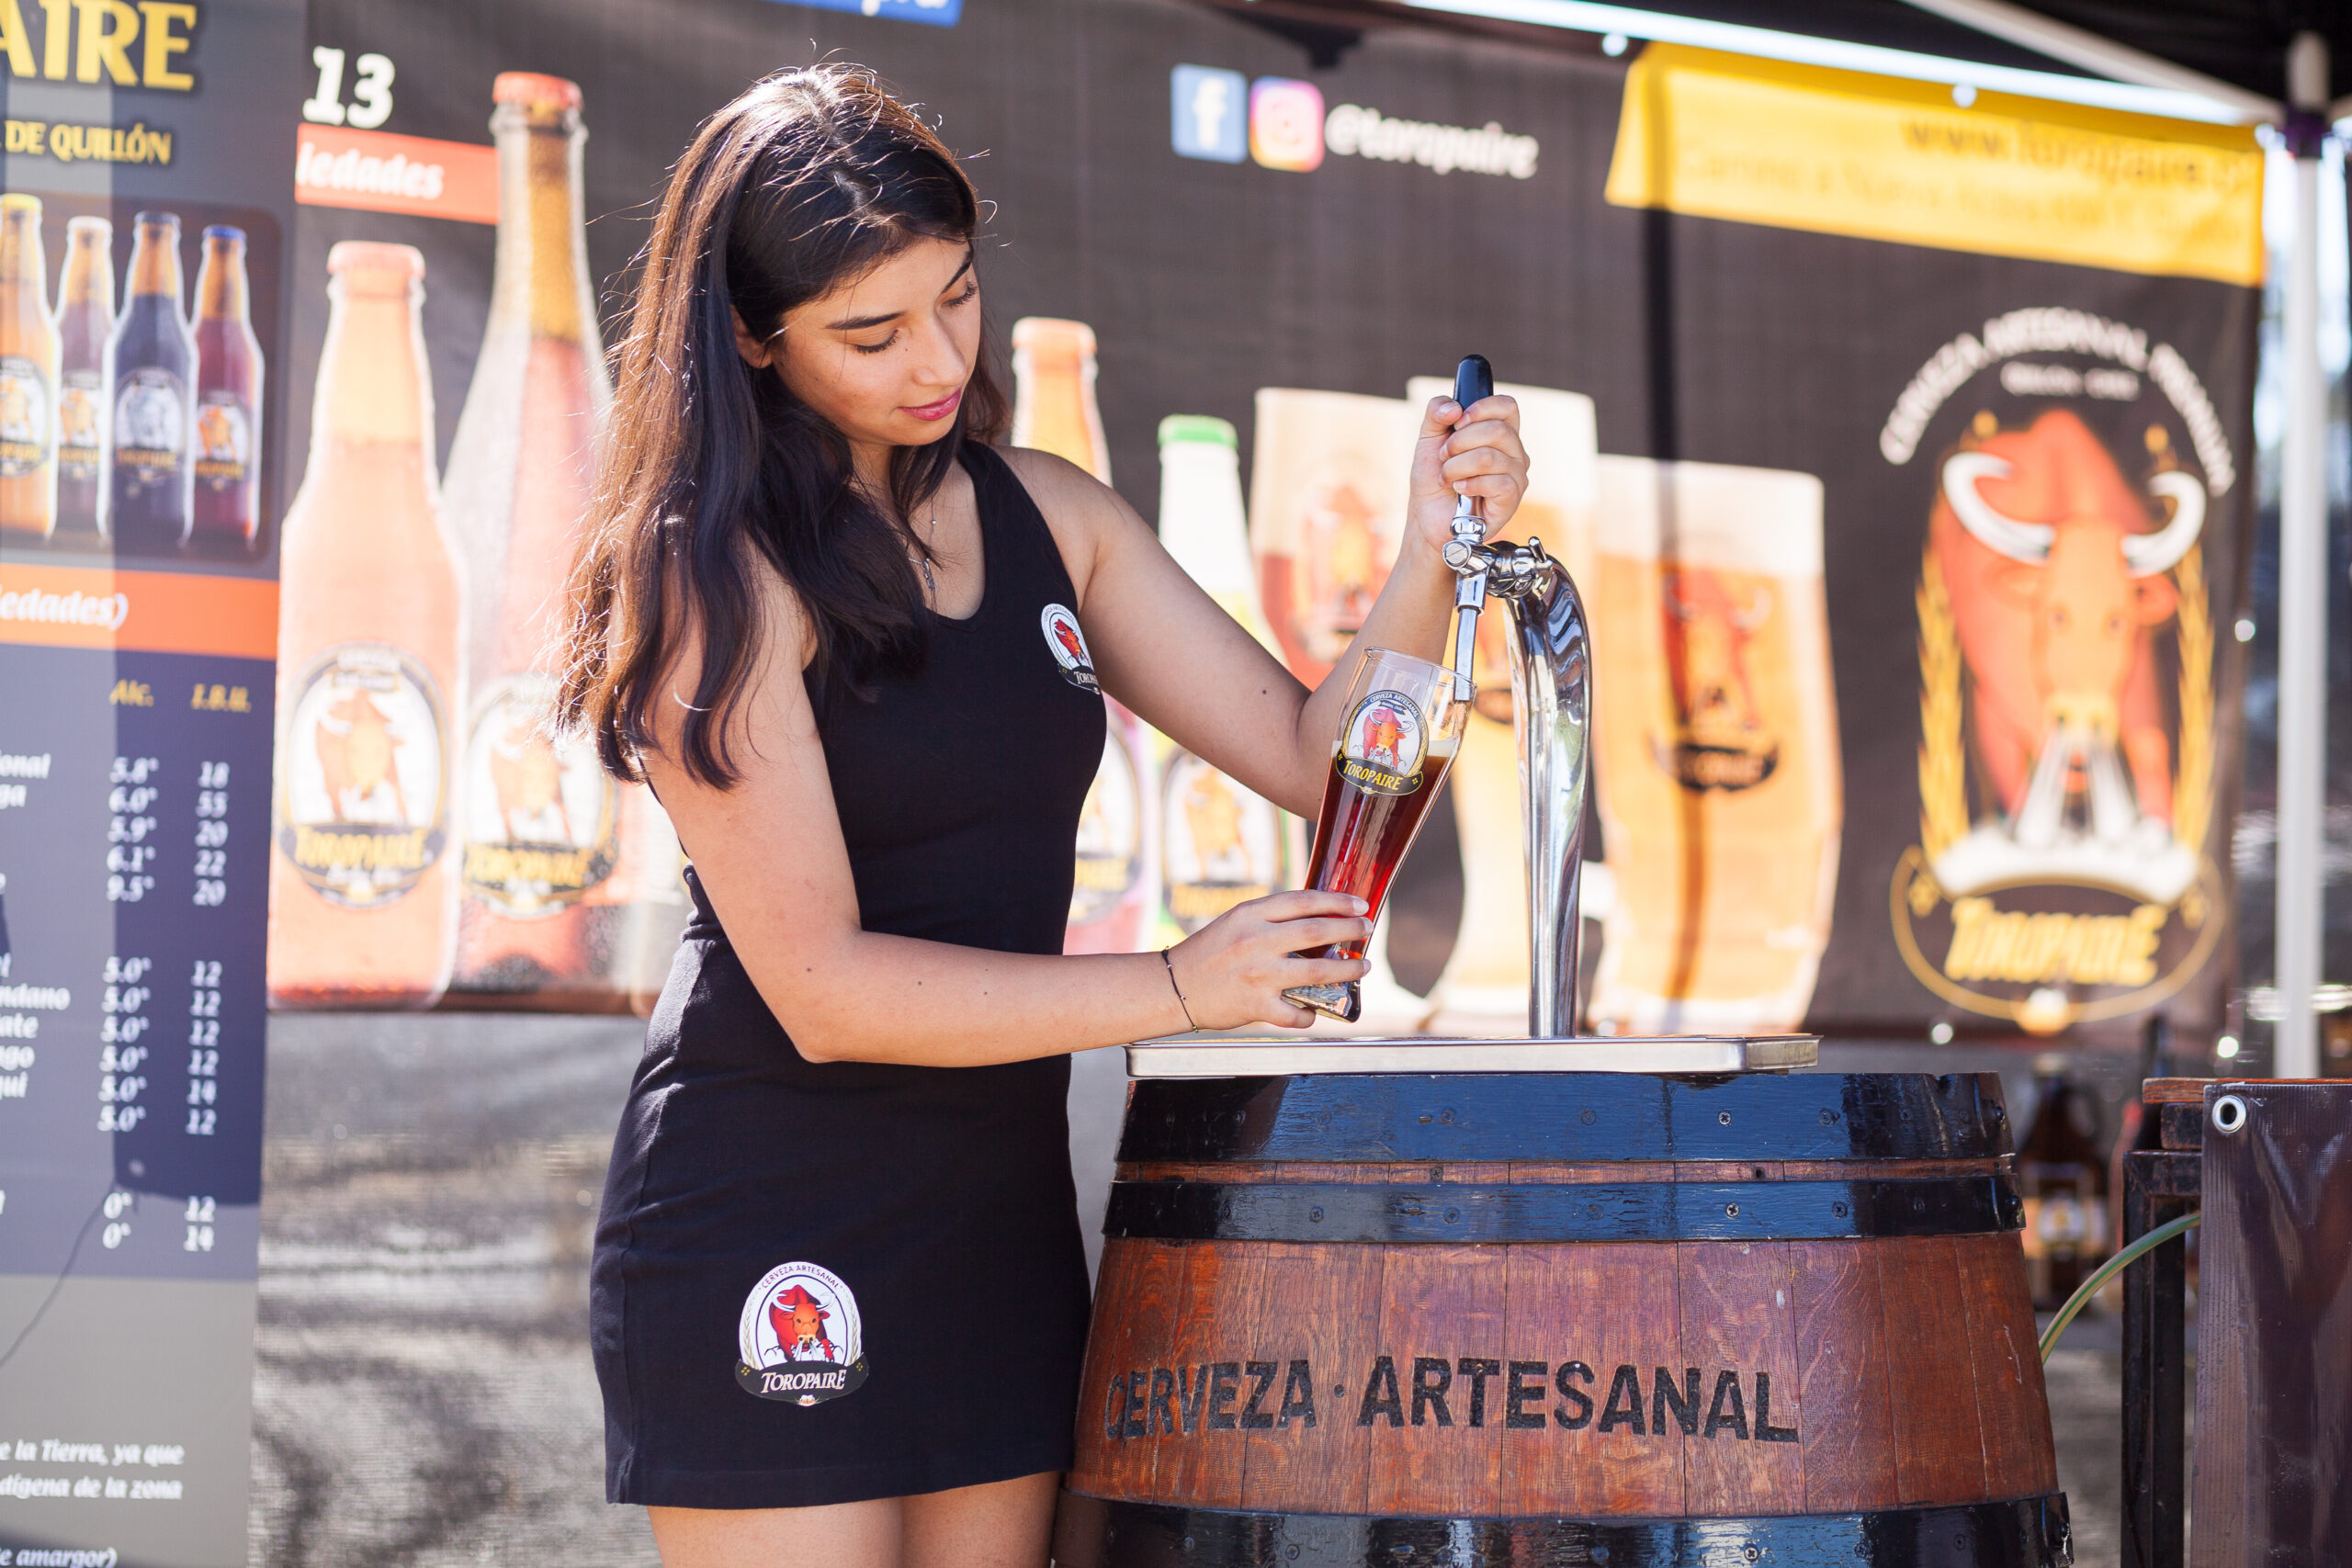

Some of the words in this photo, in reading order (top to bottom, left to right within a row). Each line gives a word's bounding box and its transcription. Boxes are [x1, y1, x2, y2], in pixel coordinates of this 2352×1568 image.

[302, 46, 395, 128] 13
[5, 120, 46, 154] DE
[50, 122, 172, 165] QUILLÓN
[0, 585, 128, 631] edades)
[1370, 694, 1393, 703] CERVEZA
[1393, 694, 1419, 718] ARTESANAL
[0, 750, 51, 779] onal
[1343, 760, 1404, 791] TOROPAIRE
[190, 960, 222, 987] 12
[189, 990, 221, 1017] 12
[188, 1020, 220, 1046] 12
[0, 1045, 35, 1070] go
[187, 1049, 219, 1076] 12
[186, 1109, 217, 1135] 12
[184, 1195, 216, 1223] 12
[761, 1266, 794, 1289] CERVEZA
[796, 1265, 839, 1289] ARTESANAL
[761, 1370, 847, 1393] TOROPAIRE
[1104, 1358, 1317, 1438] CERVEZA
[1356, 1355, 1800, 1442] ARTESANAL
[15, 1438, 38, 1461] la
[41, 1438, 108, 1466] Tierra,
[111, 1443, 141, 1466] ya
[143, 1444, 185, 1467] que
[73, 1475, 102, 1498] de
[104, 1476, 128, 1498] la
[130, 1479, 183, 1500] zona
[16, 1546, 118, 1568] amargor)
